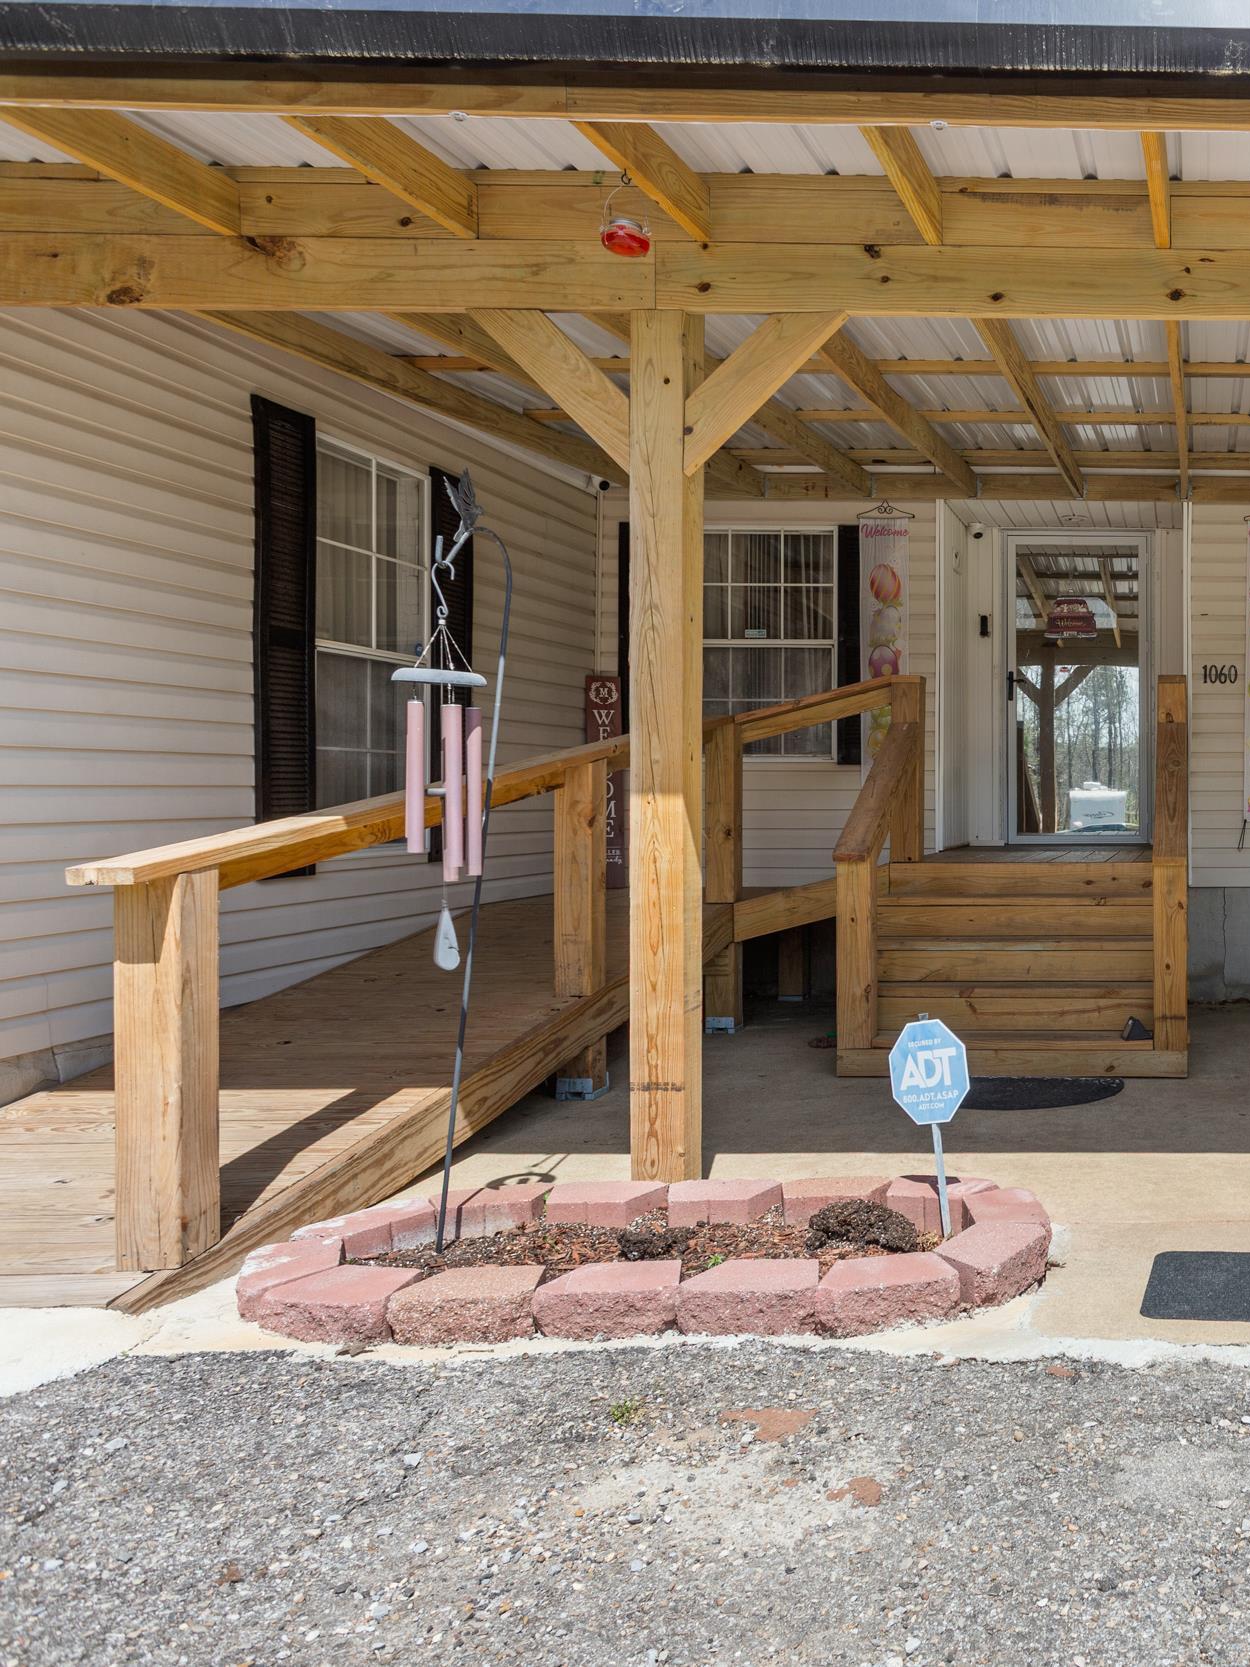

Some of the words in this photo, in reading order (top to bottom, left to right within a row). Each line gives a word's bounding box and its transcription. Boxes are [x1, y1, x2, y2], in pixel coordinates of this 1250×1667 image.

[861, 523, 910, 539] Welcome
[1202, 664, 1238, 684] 1060
[599, 687, 609, 698] M
[899, 1047, 957, 1091] ADT
